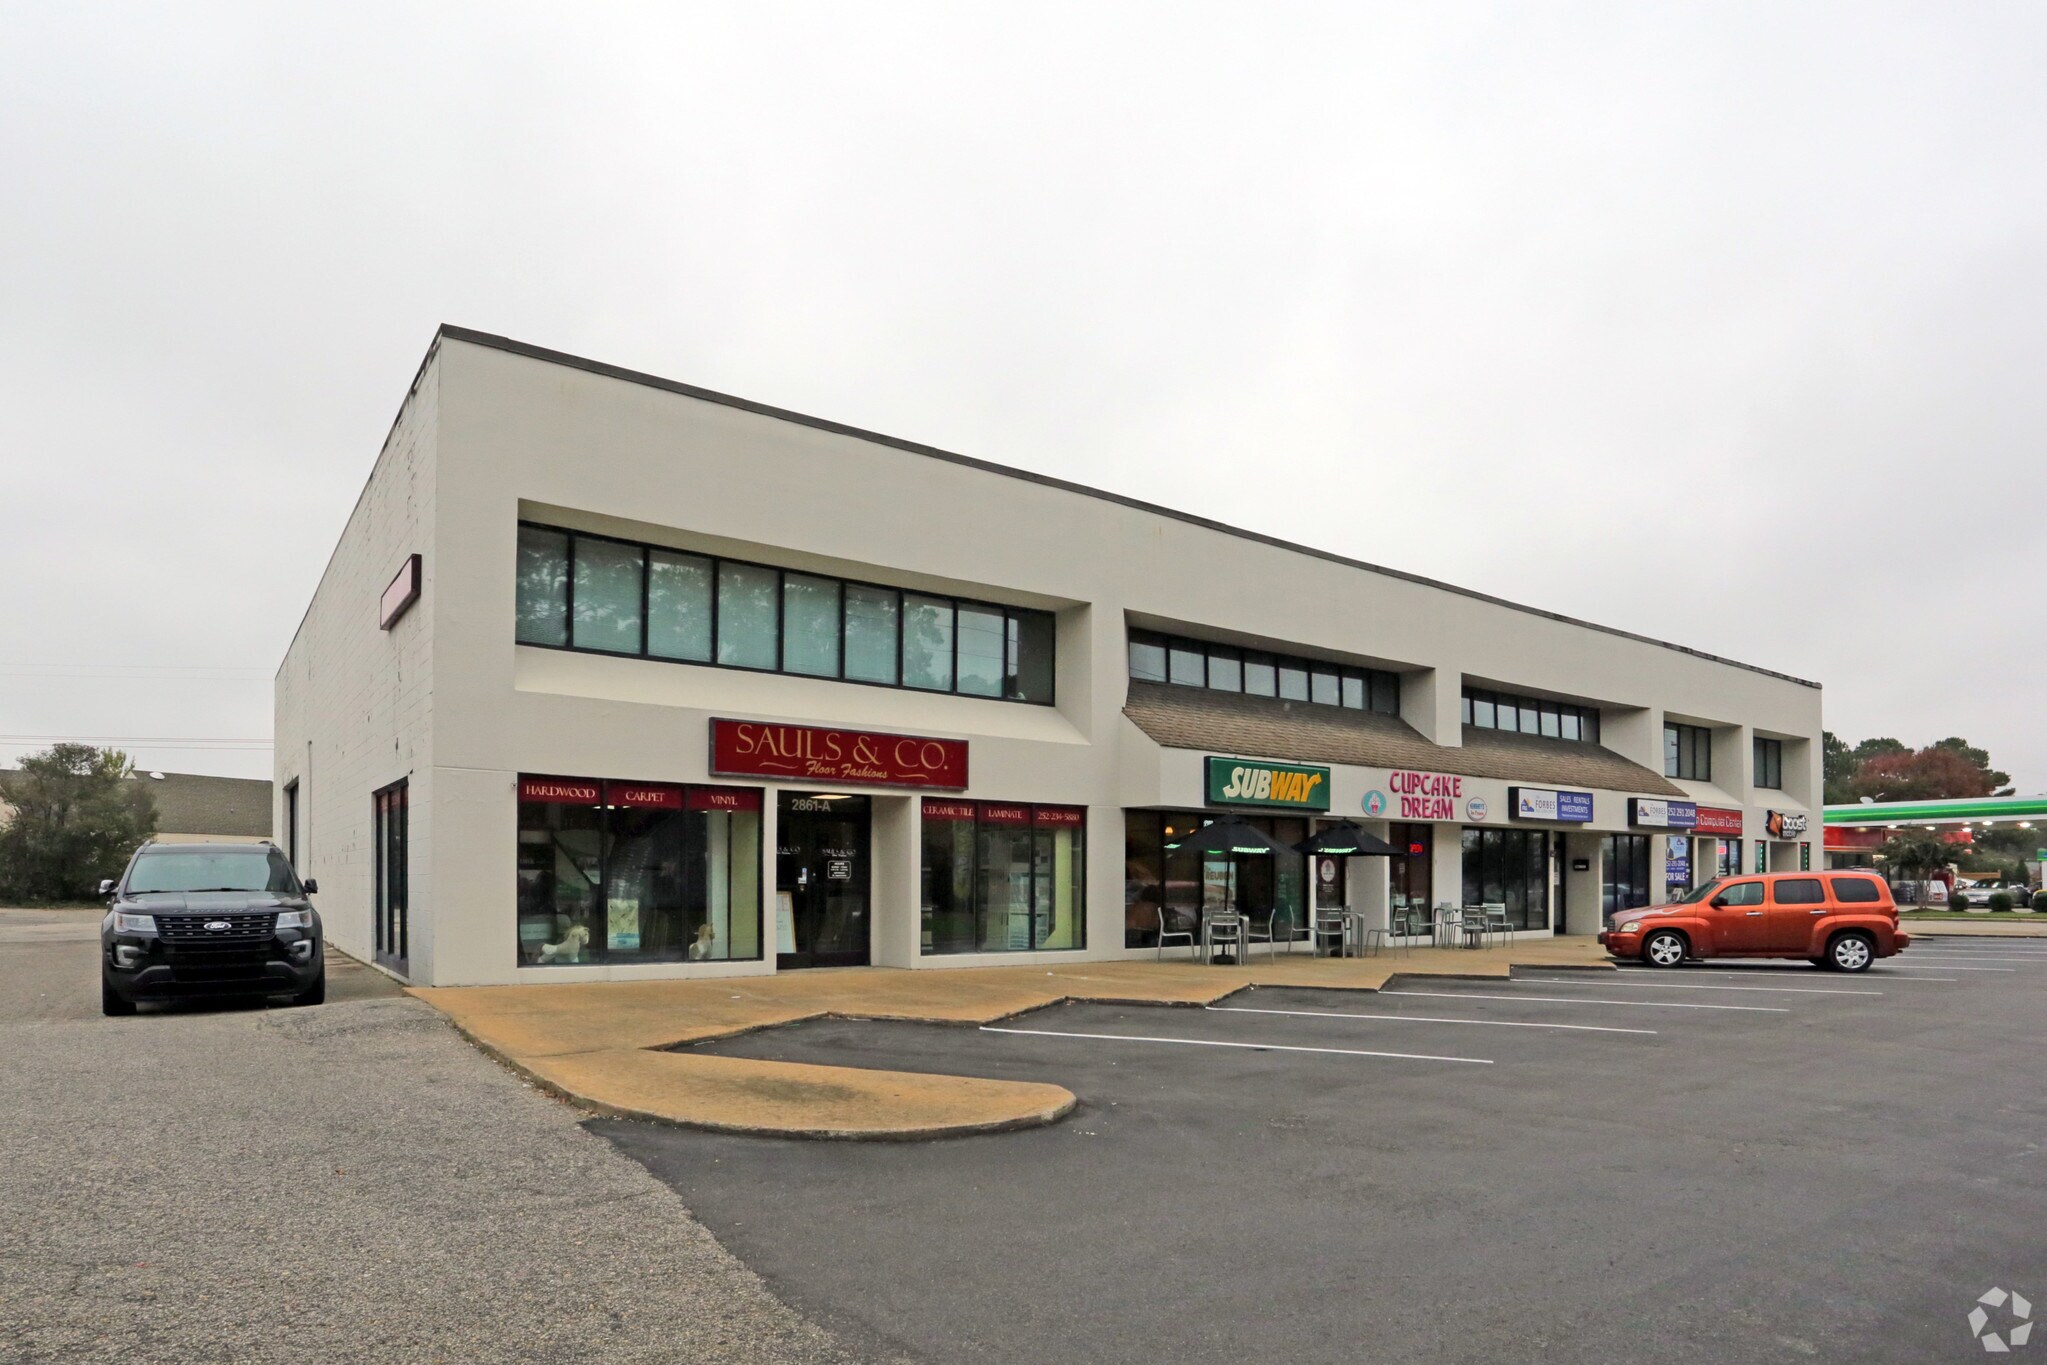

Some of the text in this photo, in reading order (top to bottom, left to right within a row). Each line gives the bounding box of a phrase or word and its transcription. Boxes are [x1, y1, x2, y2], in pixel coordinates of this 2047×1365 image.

[736, 724, 949, 770] SAULS & CO.
[805, 760, 889, 779] Floor Fashions
[1222, 766, 1322, 802] SUBWAY
[1389, 771, 1462, 798] CUPCAKE
[526, 785, 595, 799] HARDWOOD
[625, 791, 665, 802] CARPET
[711, 795, 738, 806] VINYL
[792, 799, 831, 812] 2861-A
[1535, 800, 1556, 810] FORBES
[1559, 795, 1571, 803] SALES
[923, 806, 974, 816] CERAMIC TILE
[988, 809, 1023, 819] LAMINATE
[1401, 795, 1454, 820] DREAM
[1561, 805, 1589, 814] INVESTMENTS
[1782, 814, 1807, 831] boost
